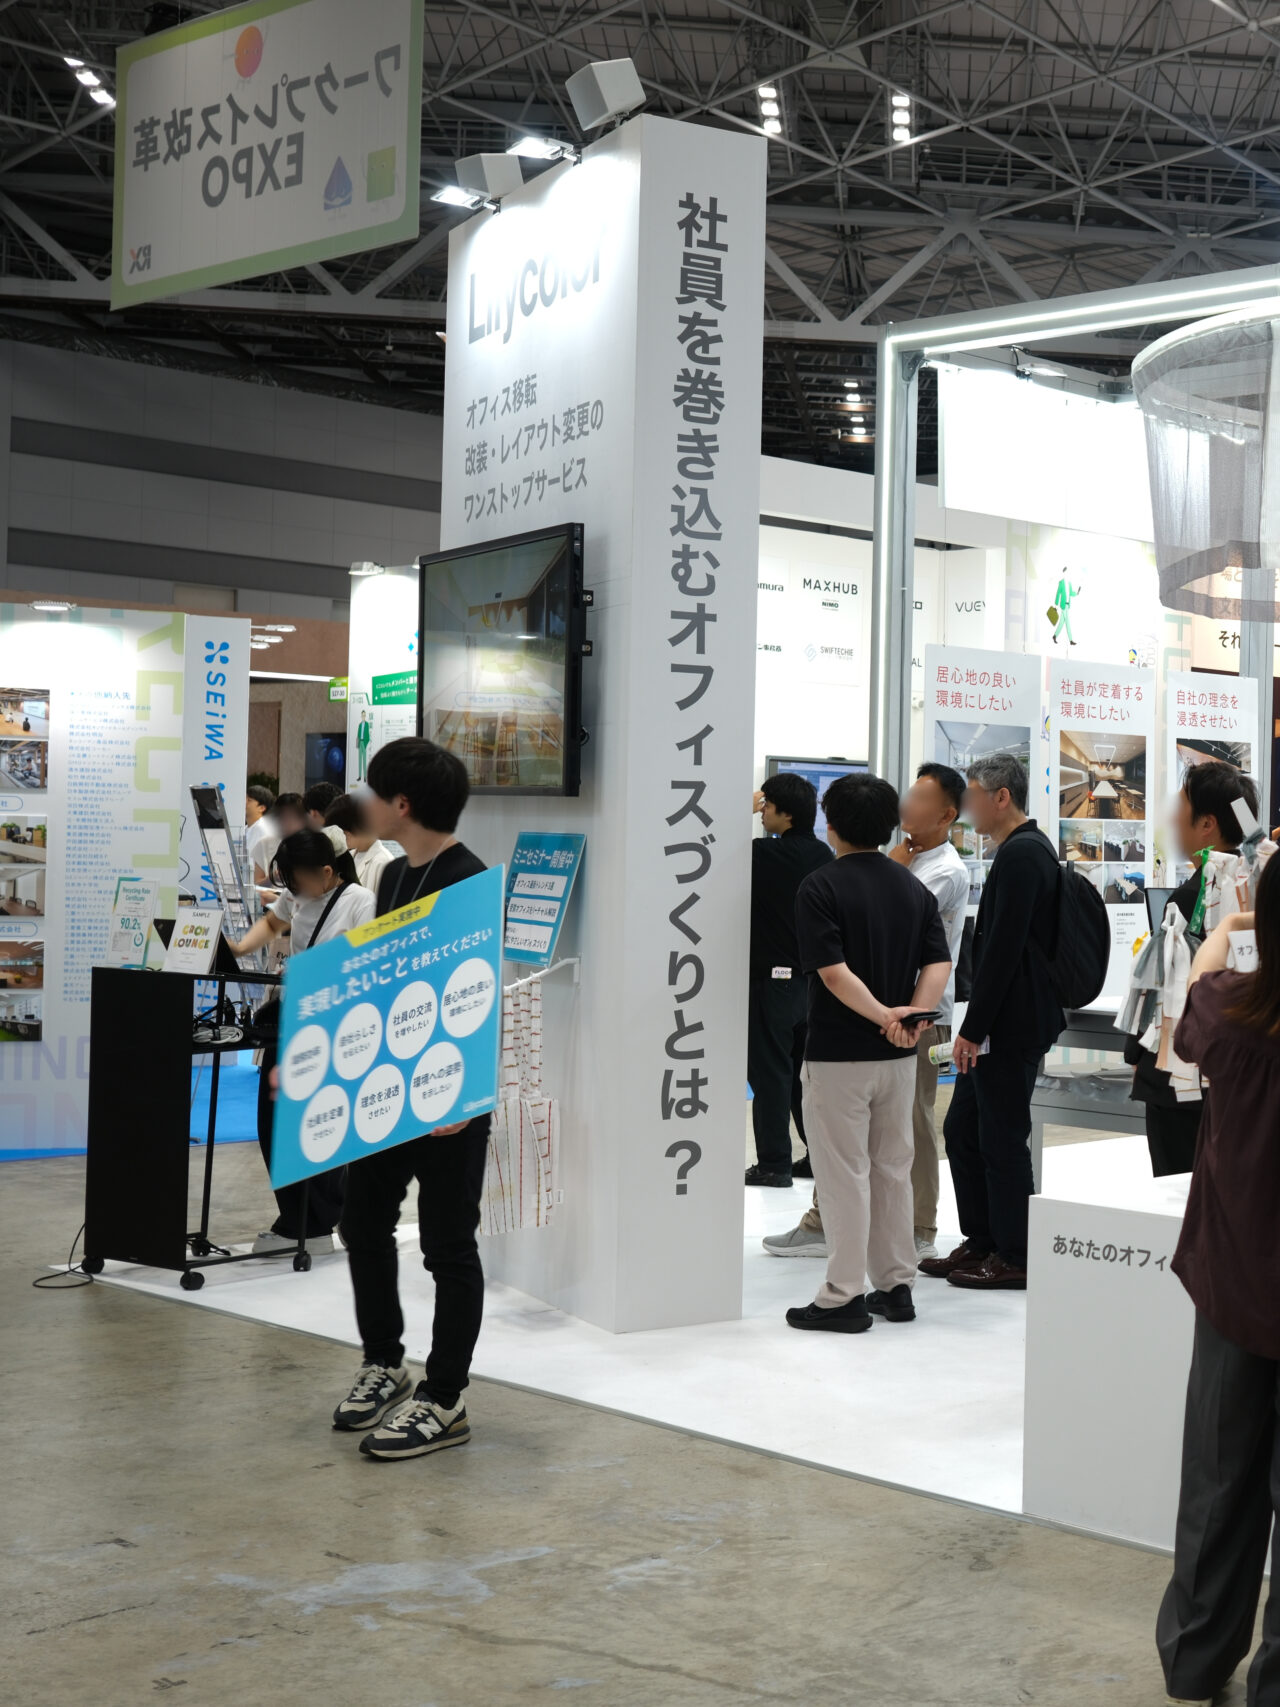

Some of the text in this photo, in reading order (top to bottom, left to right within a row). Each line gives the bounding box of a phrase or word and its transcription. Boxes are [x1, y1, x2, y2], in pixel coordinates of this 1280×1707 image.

[466, 373, 537, 429] オフィス移転
[465, 399, 604, 477] 改装・レイアウト変更の
[464, 457, 588, 523] ワンストップサービス
[803, 577, 858, 595] MAXHUB
[821, 601, 839, 609] NIMO
[757, 643, 782, 653] ン事務器
[820, 645, 854, 657] SWIFTECHIE
[936, 666, 1017, 688] 居心地の良い
[936, 690, 1013, 711] 環境にしたい
[1060, 679, 1143, 702] 社員が定着する
[1177, 690, 1239, 710] 自社の理念を
[1060, 702, 1130, 721] 環境にしたい
[1176, 711, 1238, 729] 浸透させたい
[513, 848, 575, 869] ミニセミナー開催中
[392, 1001, 432, 1026] 社員の交流
[394, 1019, 430, 1039] を増やしたい
[361, 1084, 400, 1108] 理念を浸透
[368, 1105, 391, 1120] させたい
[1053, 1234, 1168, 1271] あなたのオフィ
